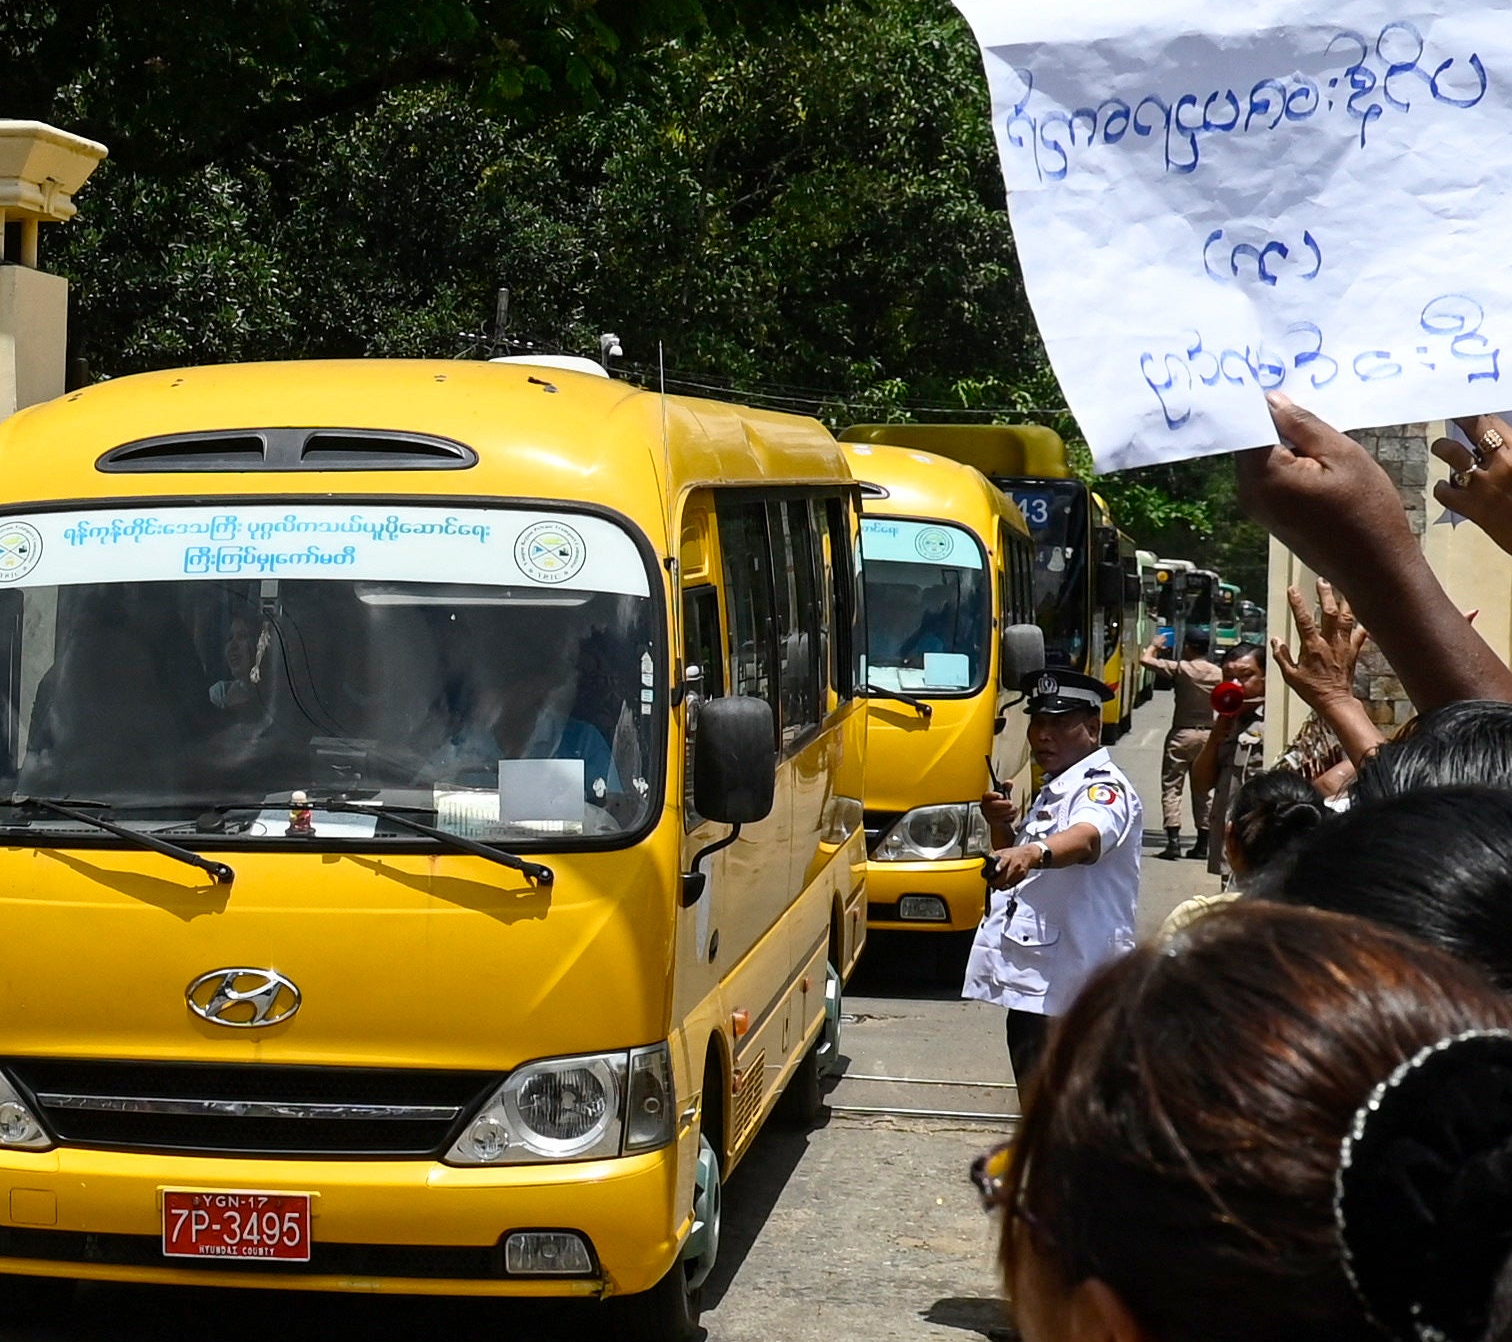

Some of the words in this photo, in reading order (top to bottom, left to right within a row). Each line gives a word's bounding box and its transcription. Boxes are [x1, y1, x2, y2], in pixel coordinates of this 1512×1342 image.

[63, 515, 243, 546] ရန်ကုန်တိုင်းဒေသကြီး
[183, 546, 356, 574] ကြီးကြပ်မှုကော်မတီ
[202, 1195, 269, 1209] YGN-17
[170, 1208, 300, 1247] 7P-3495
